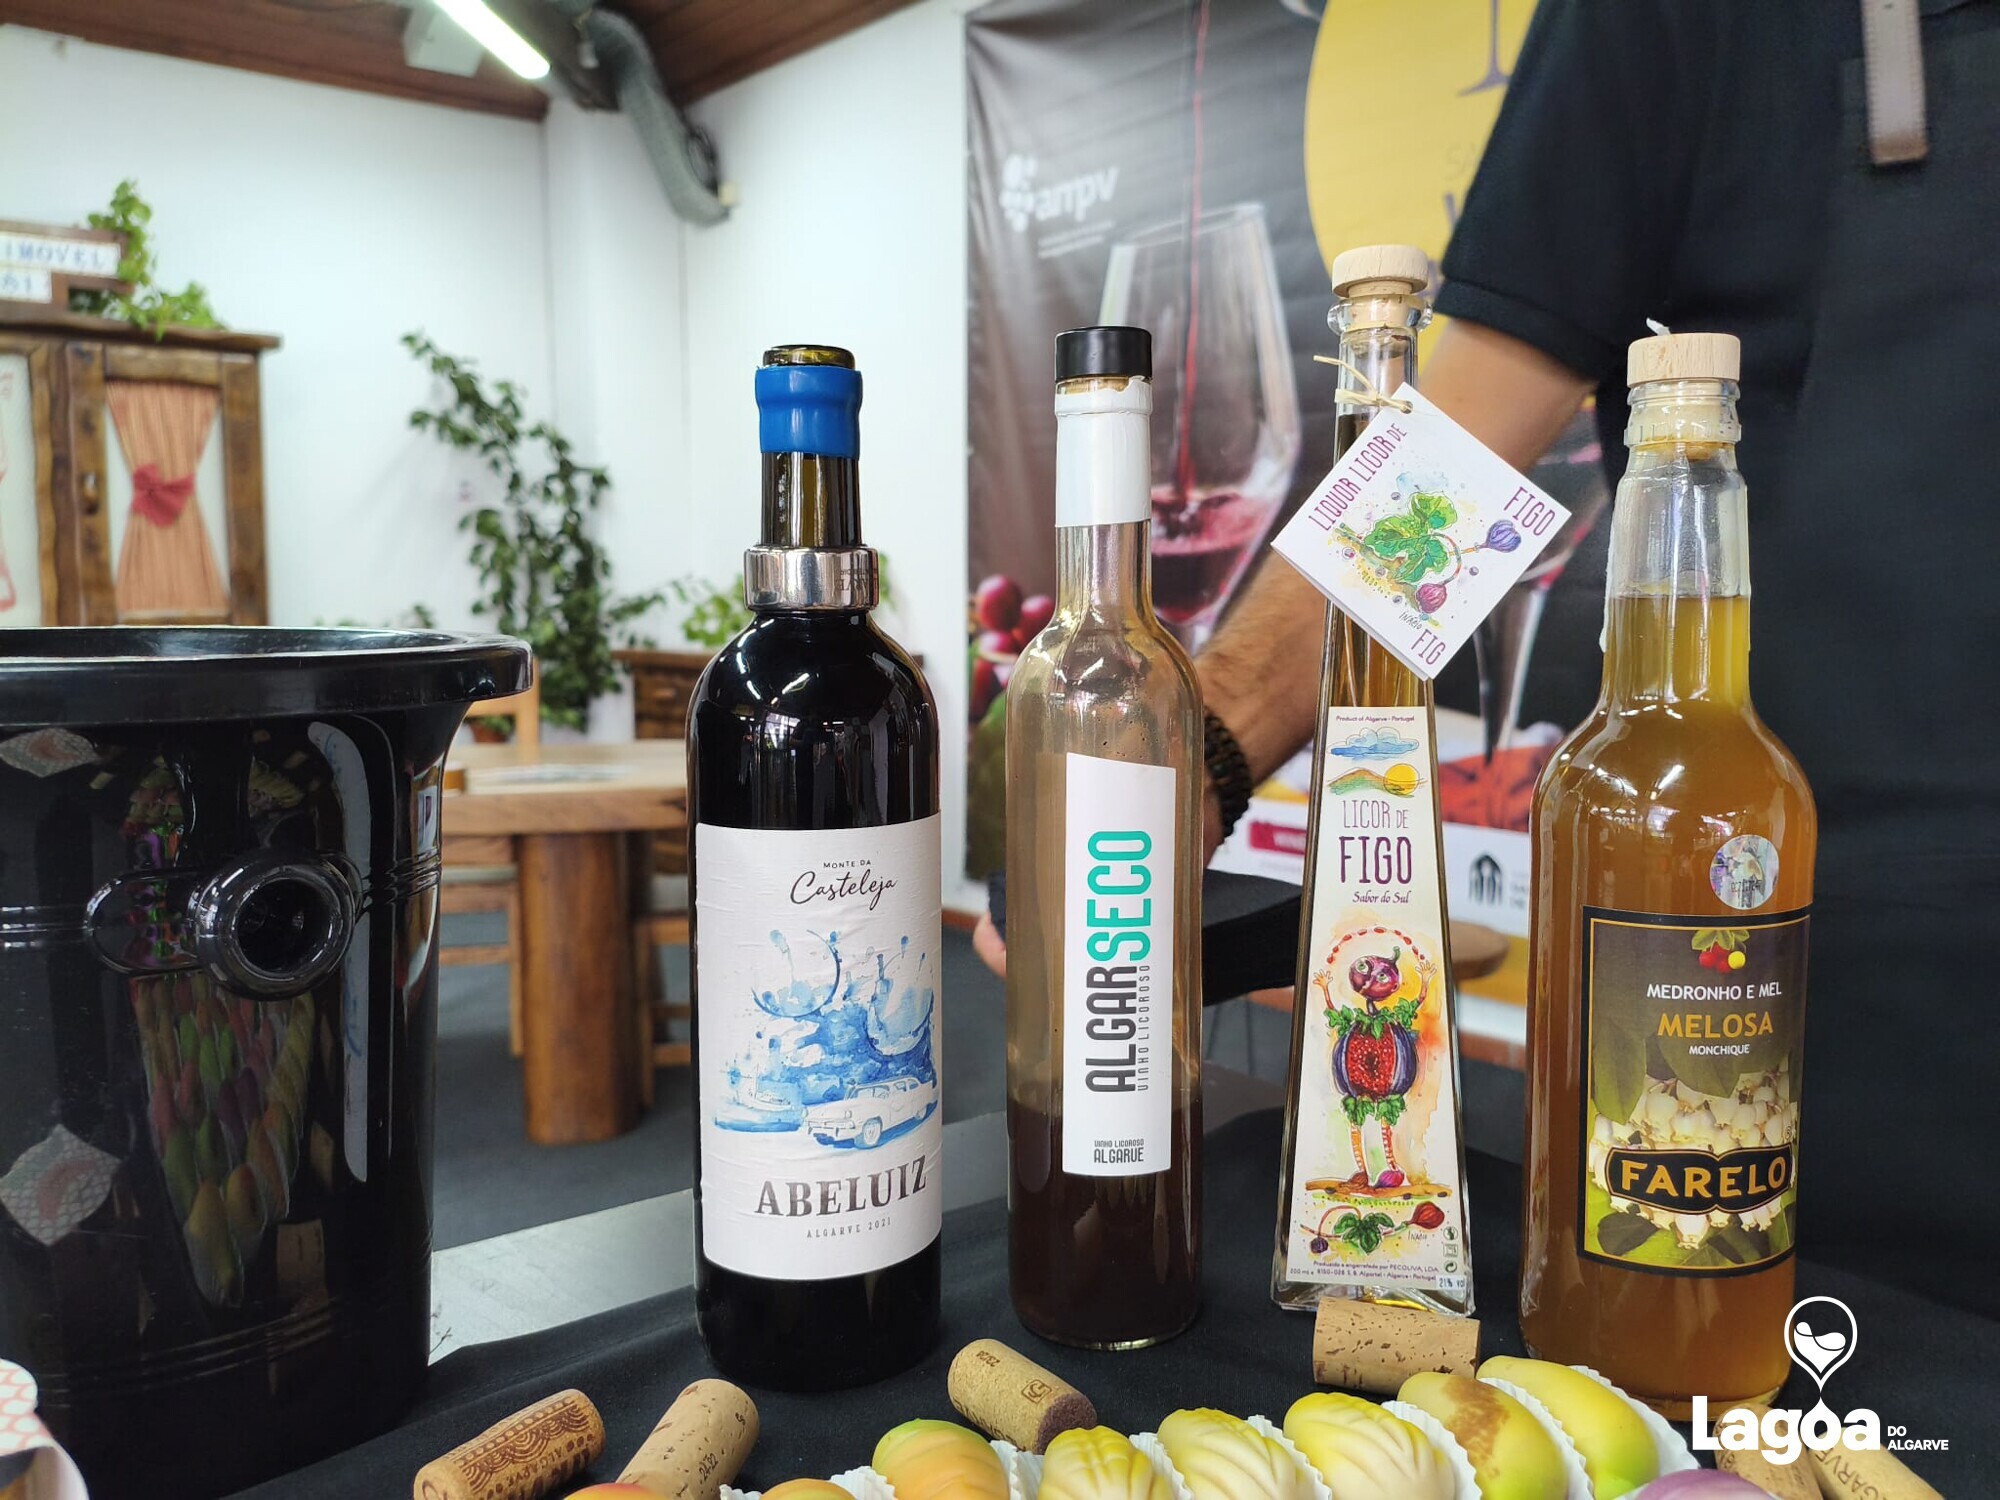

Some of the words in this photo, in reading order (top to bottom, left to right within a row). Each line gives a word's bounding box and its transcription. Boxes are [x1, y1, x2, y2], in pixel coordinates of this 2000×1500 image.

[1308, 477, 1362, 532] LIQUOR
[1503, 486, 1556, 536] FIGO
[1410, 628, 1446, 665] FIG
[1342, 799, 1391, 829] LICOR
[1396, 809, 1409, 829] DE
[823, 860, 856, 870] MONTE
[860, 859, 872, 867] DA
[1338, 835, 1413, 885] FIGO
[790, 868, 898, 911] Casteleja
[1352, 889, 1380, 904] Sabor
[1393, 890, 1412, 904] Sul
[1138, 964, 1151, 1040] LICOROSO
[1646, 983, 1742, 1001] MEDRONHO
[1746, 984, 1755, 999] E
[1759, 981, 1782, 998] MEL
[1657, 1011, 1774, 1039] MELOSA
[1689, 1043, 1750, 1057] MONCHIQUE
[754, 1155, 927, 1217] ABELUIZ
[1621, 1156, 1787, 1199] FARELO
[806, 1223, 861, 1239] ALGARVE
[868, 1216, 892, 1231] 2021
[506, 1446, 562, 1487] ALGARVE
